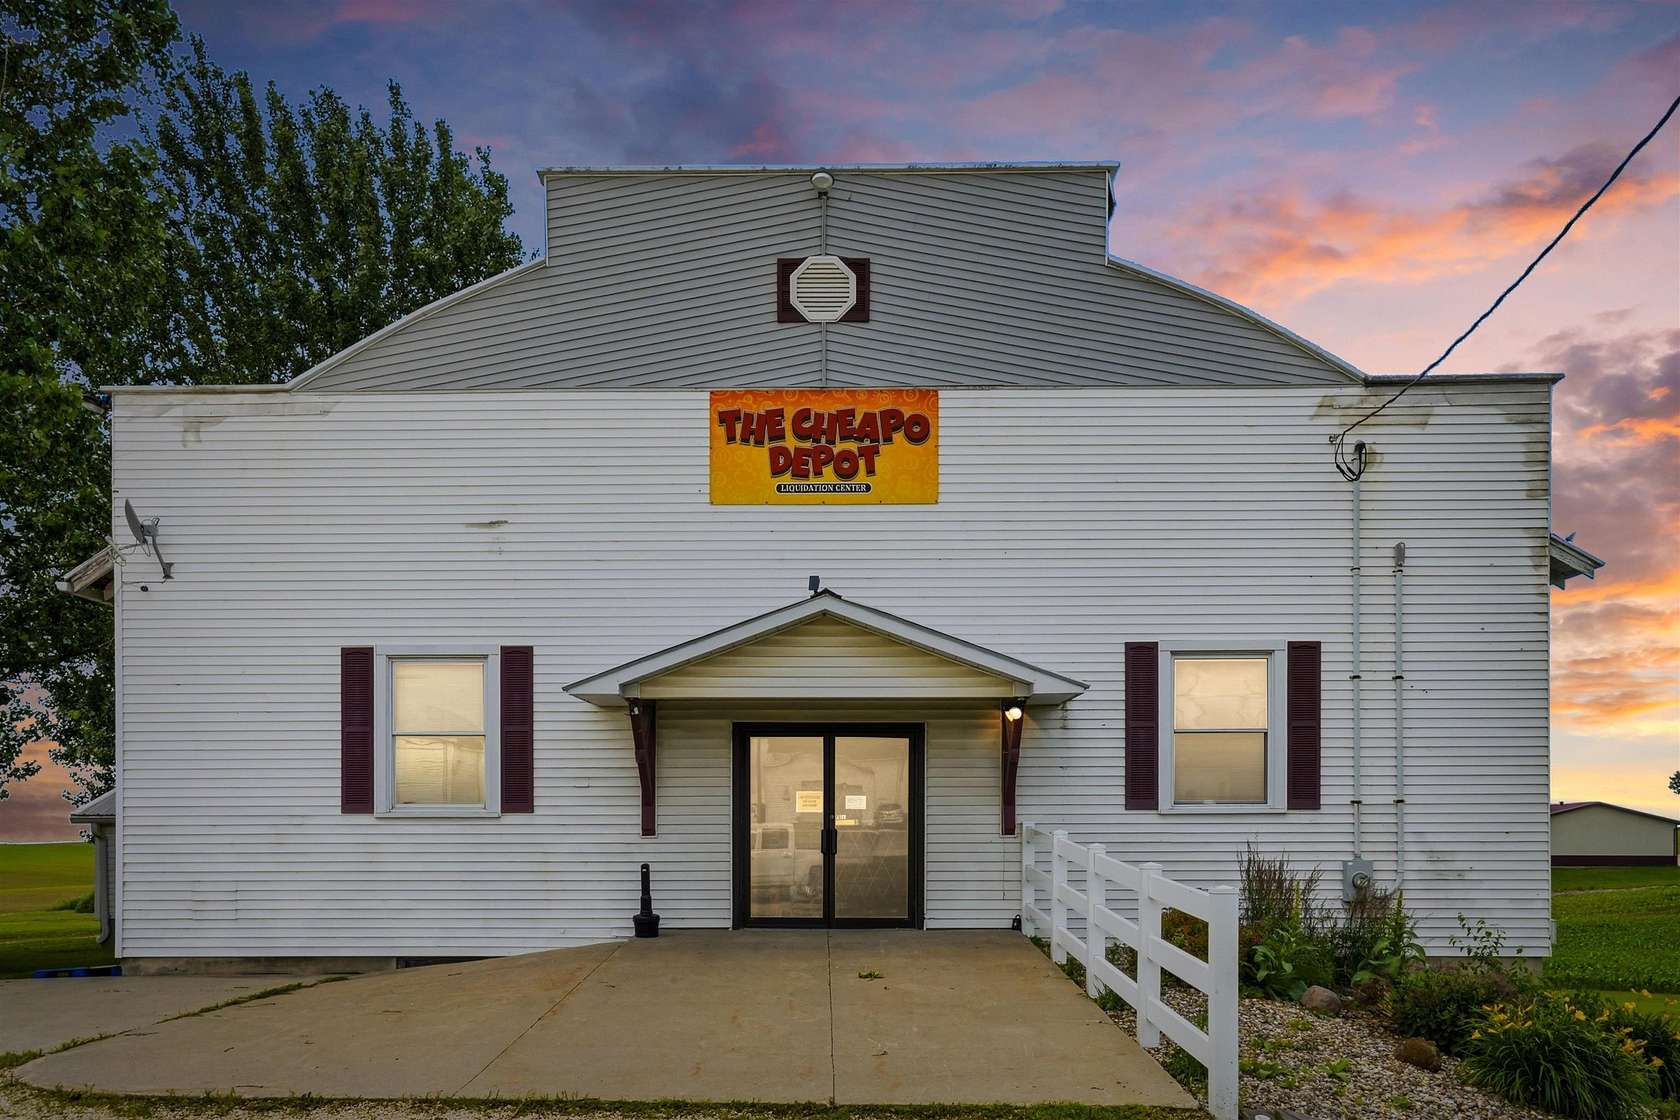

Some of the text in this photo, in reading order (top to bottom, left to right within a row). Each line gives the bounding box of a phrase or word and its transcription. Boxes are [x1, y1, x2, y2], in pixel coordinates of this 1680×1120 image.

[718, 407, 931, 447] THE CHEAPO
[769, 443, 880, 481] DEPOT
[781, 484, 867, 493] LIQUIDATION CENTER
